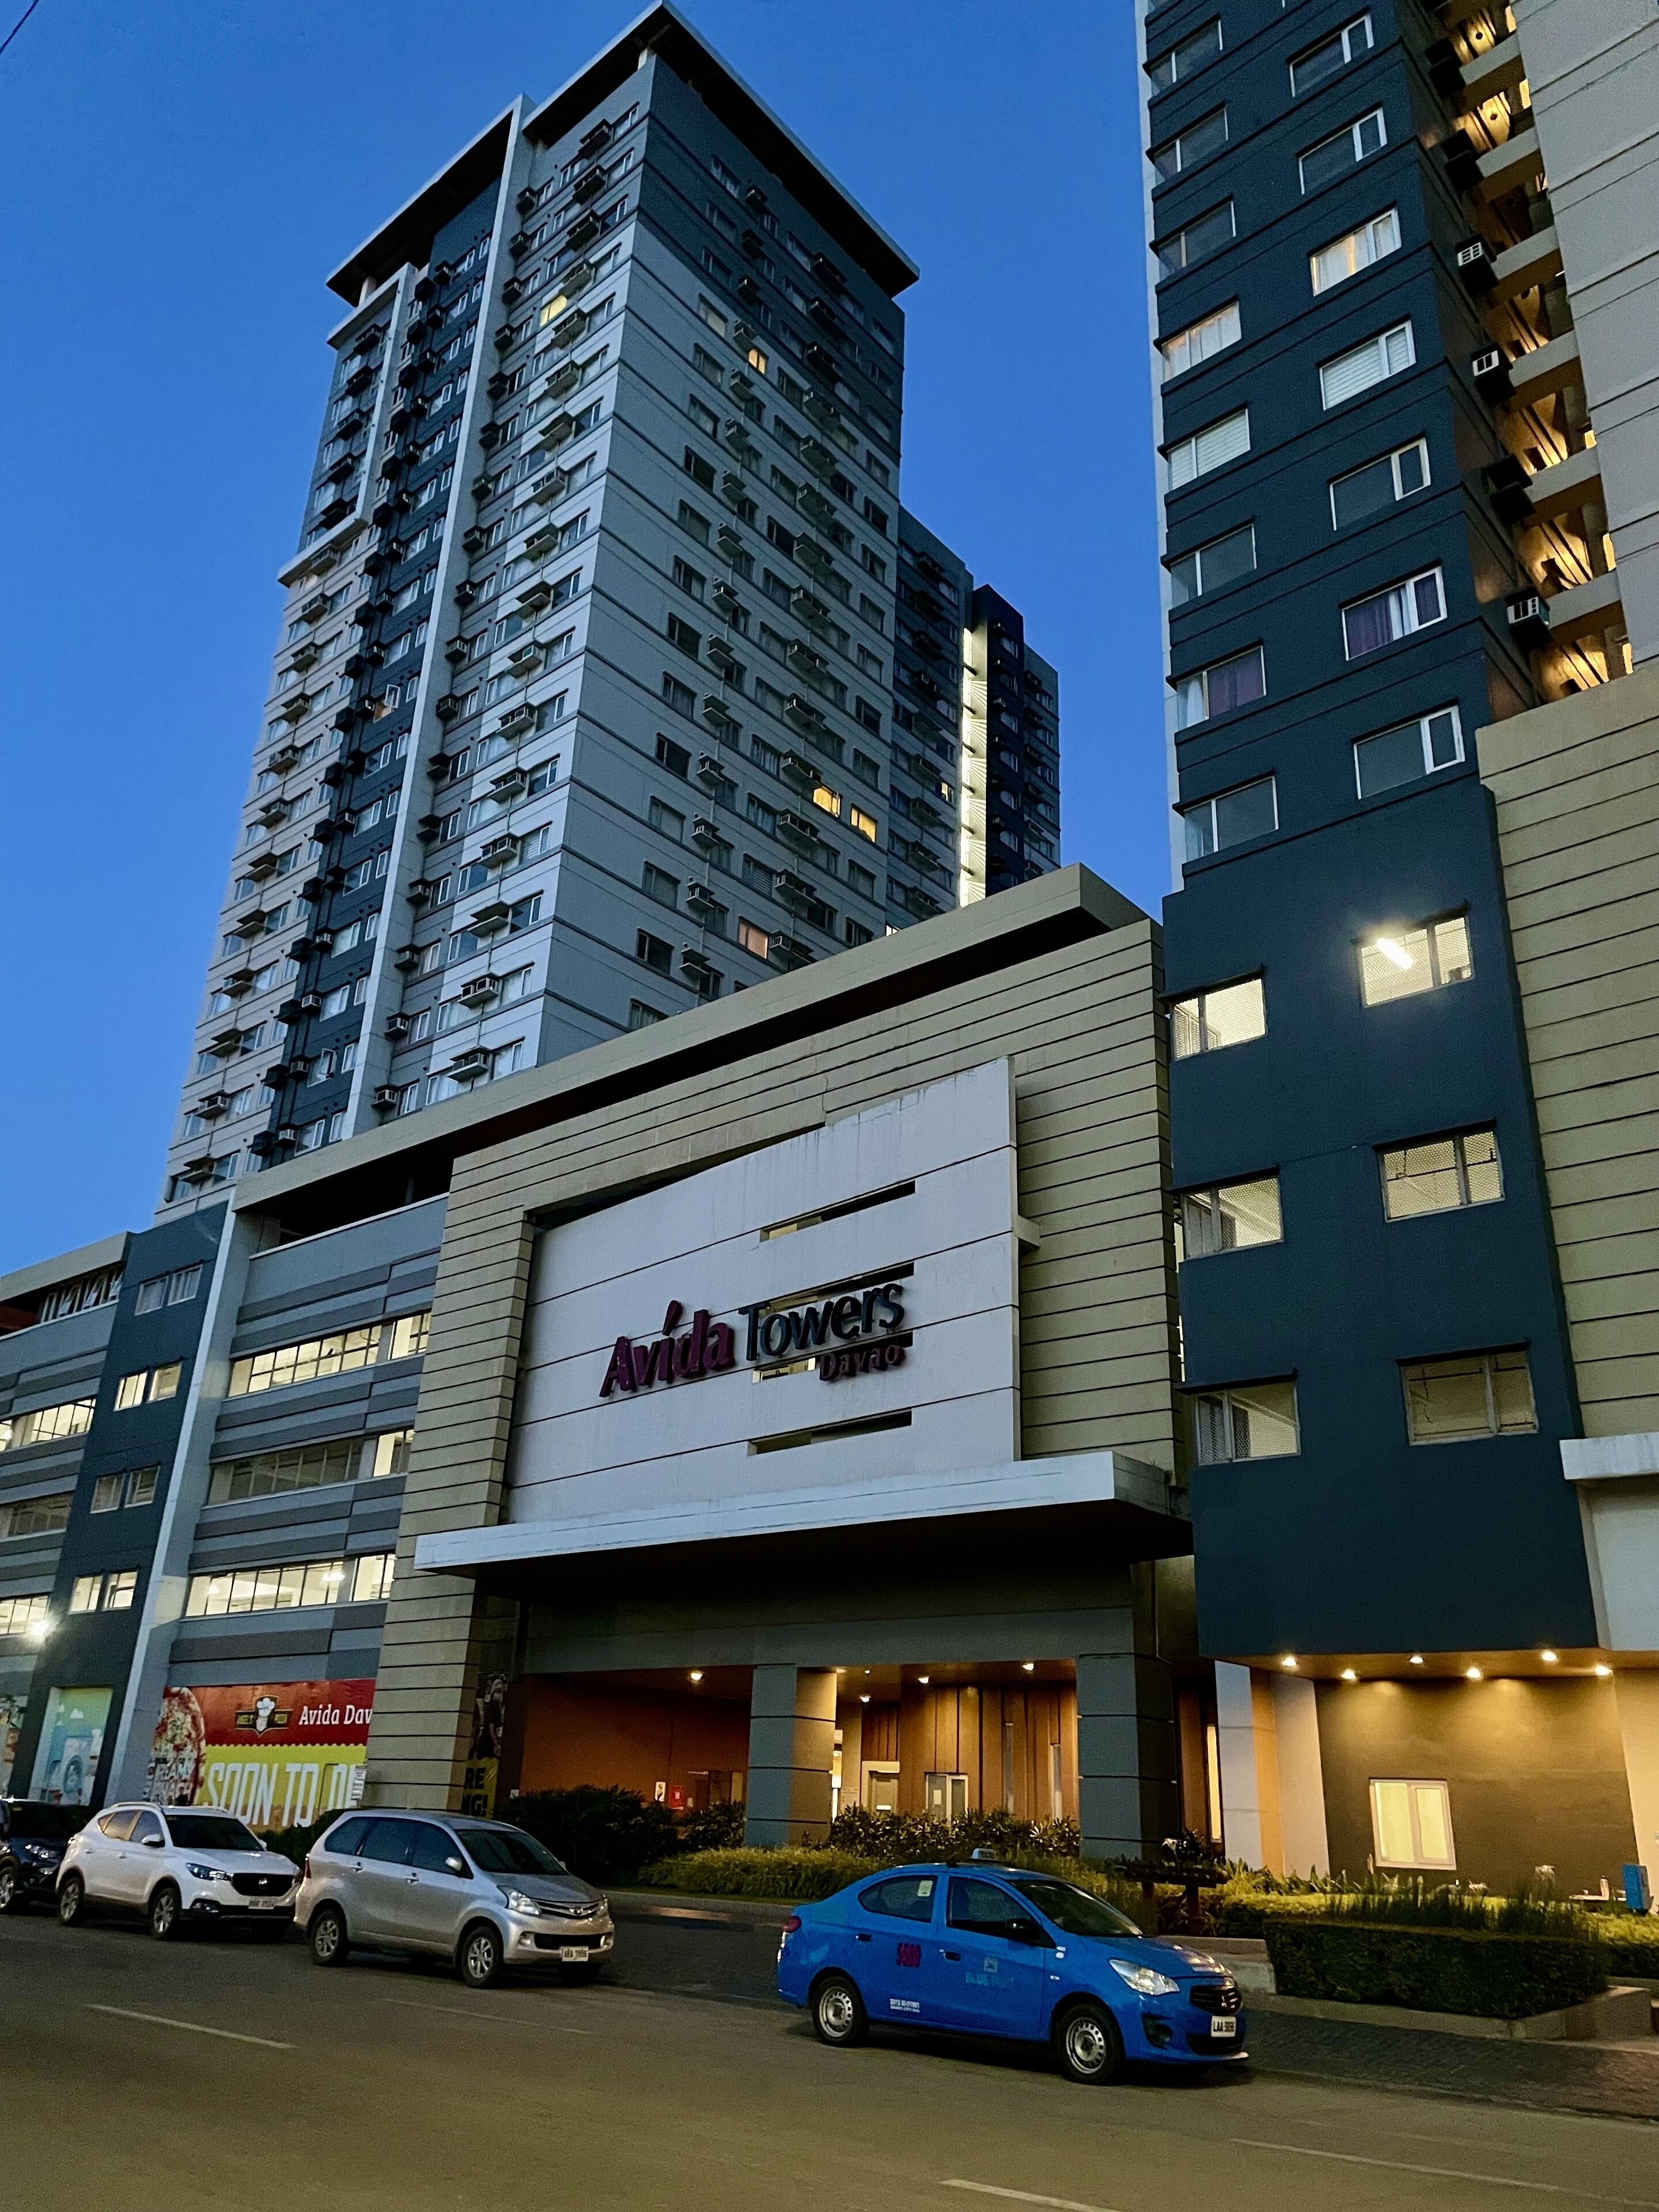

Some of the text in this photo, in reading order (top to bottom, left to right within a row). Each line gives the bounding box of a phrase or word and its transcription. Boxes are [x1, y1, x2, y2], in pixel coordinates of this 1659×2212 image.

[738, 1283, 905, 1362] Towers
[819, 1344, 906, 1381] Davao
[298, 1703, 373, 1725] Avida Dav
[202, 1762, 278, 1825] SOON
[281, 1763, 319, 1828] TO
